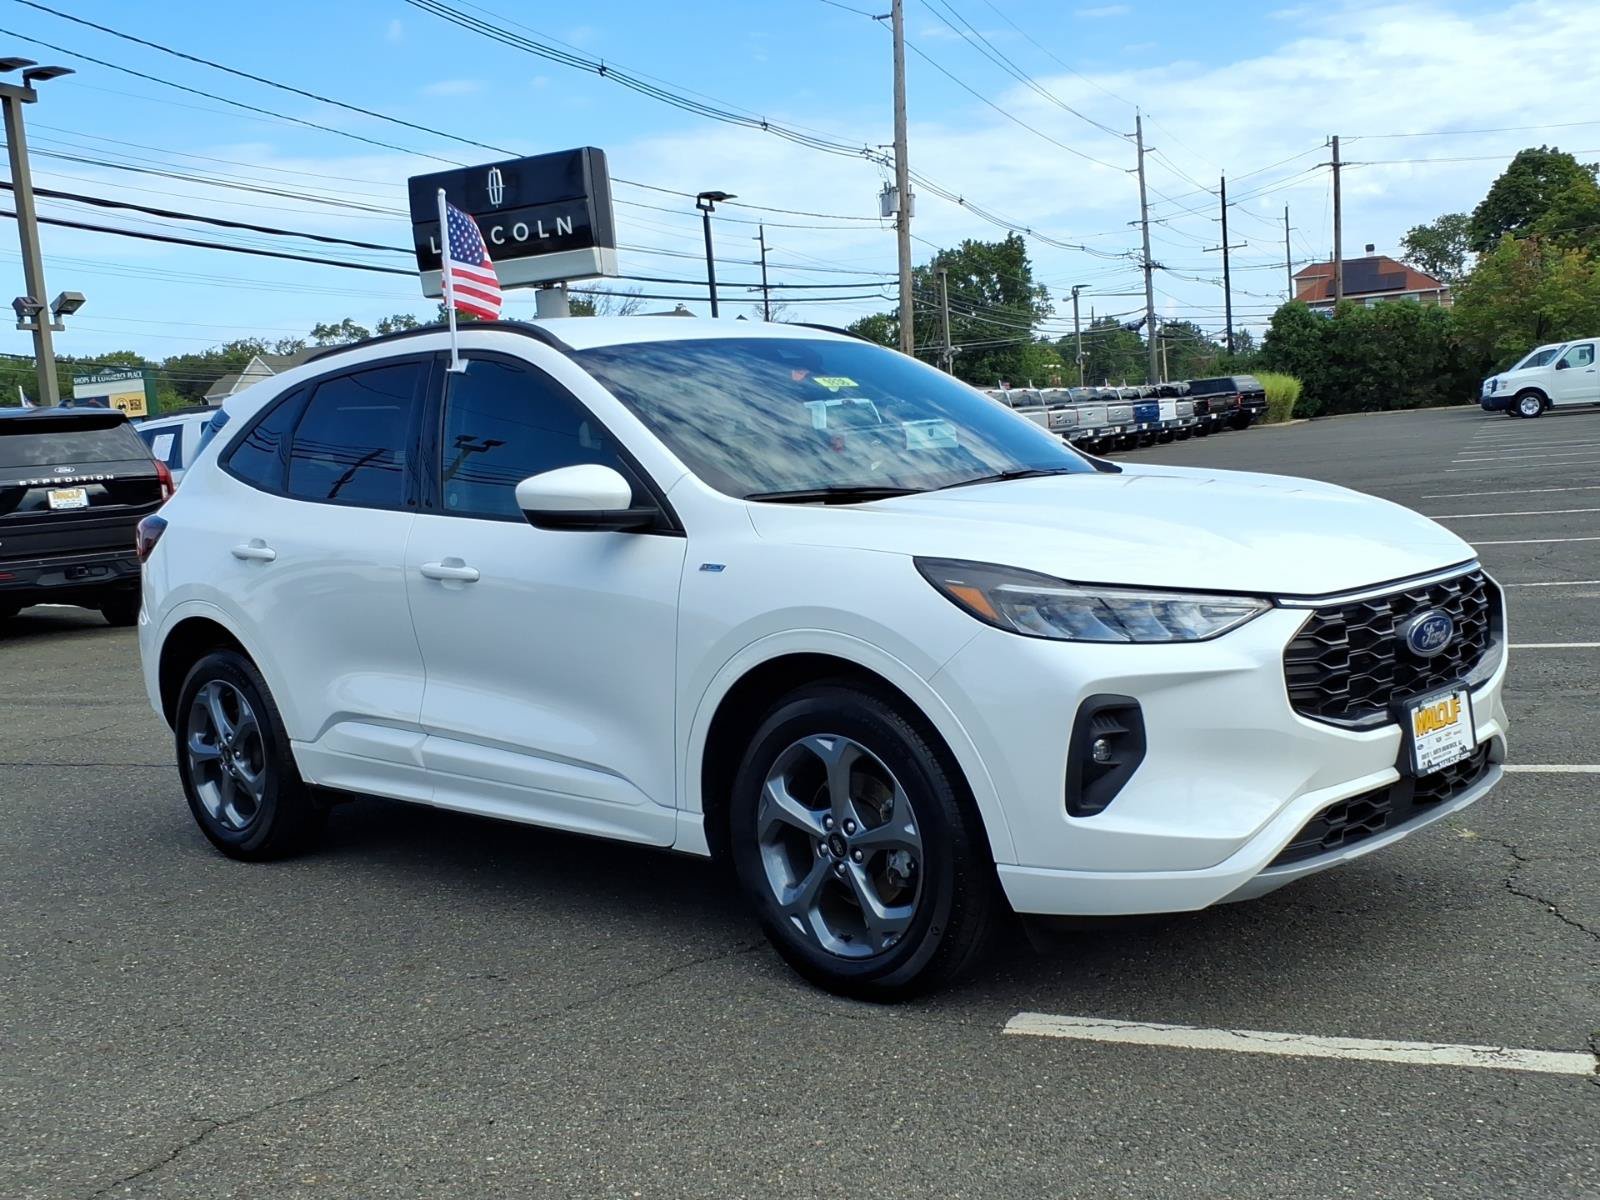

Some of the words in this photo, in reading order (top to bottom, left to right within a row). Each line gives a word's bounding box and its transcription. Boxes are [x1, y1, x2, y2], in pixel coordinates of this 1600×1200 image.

[430, 215, 573, 254] LCOLN
[19, 474, 114, 486] EXPEDITION
[1423, 620, 1447, 647] Ford
[1414, 697, 1461, 738] MALOUF
